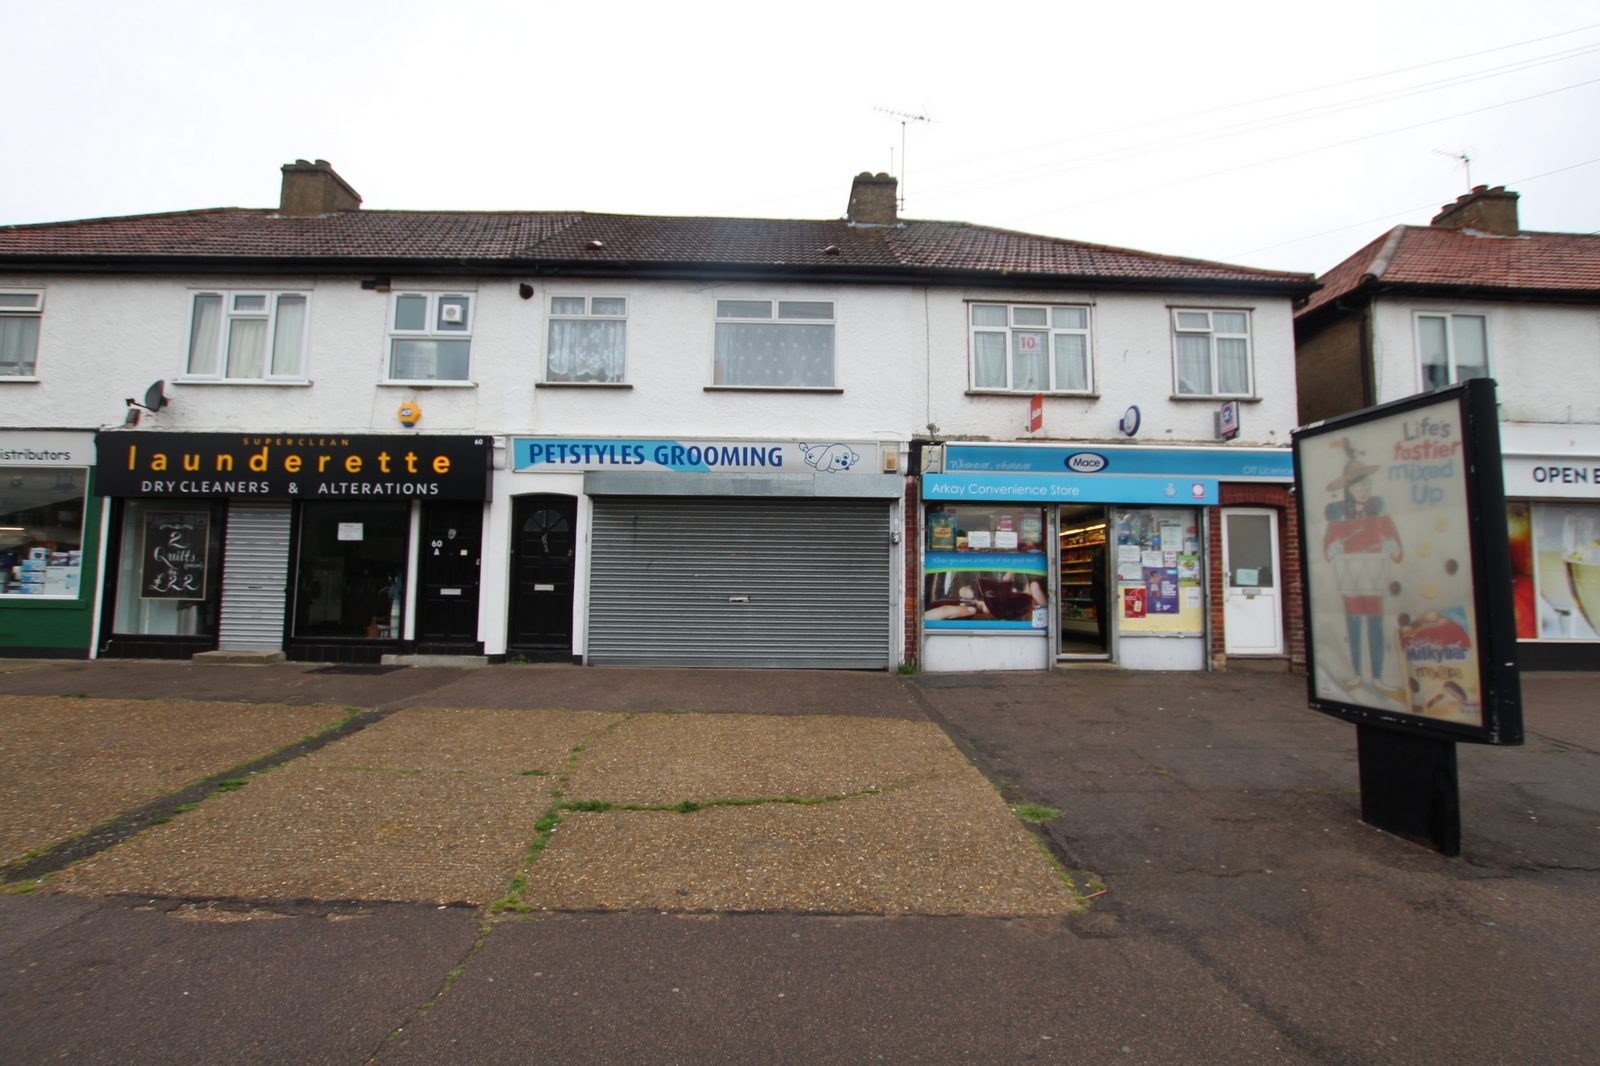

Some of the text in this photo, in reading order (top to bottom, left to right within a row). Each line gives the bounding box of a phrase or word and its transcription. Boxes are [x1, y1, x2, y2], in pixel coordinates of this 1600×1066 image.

[1020, 337, 1036, 349] 10
[1403, 417, 1451, 441] Life's
[242, 437, 349, 446] SUPERCLEAN
[128, 445, 450, 473] launderette
[529, 443, 783, 467] PETSTYLES GROOMING
[1073, 457, 1101, 468] Mace
[1533, 466, 1588, 483] OPEN
[141, 480, 439, 495] DRY CLEANERS & ALTERATIONS
[932, 483, 1080, 498] Arkay Convenience Store
[431, 540, 443, 548] 60
[149, 573, 200, 592] £22
